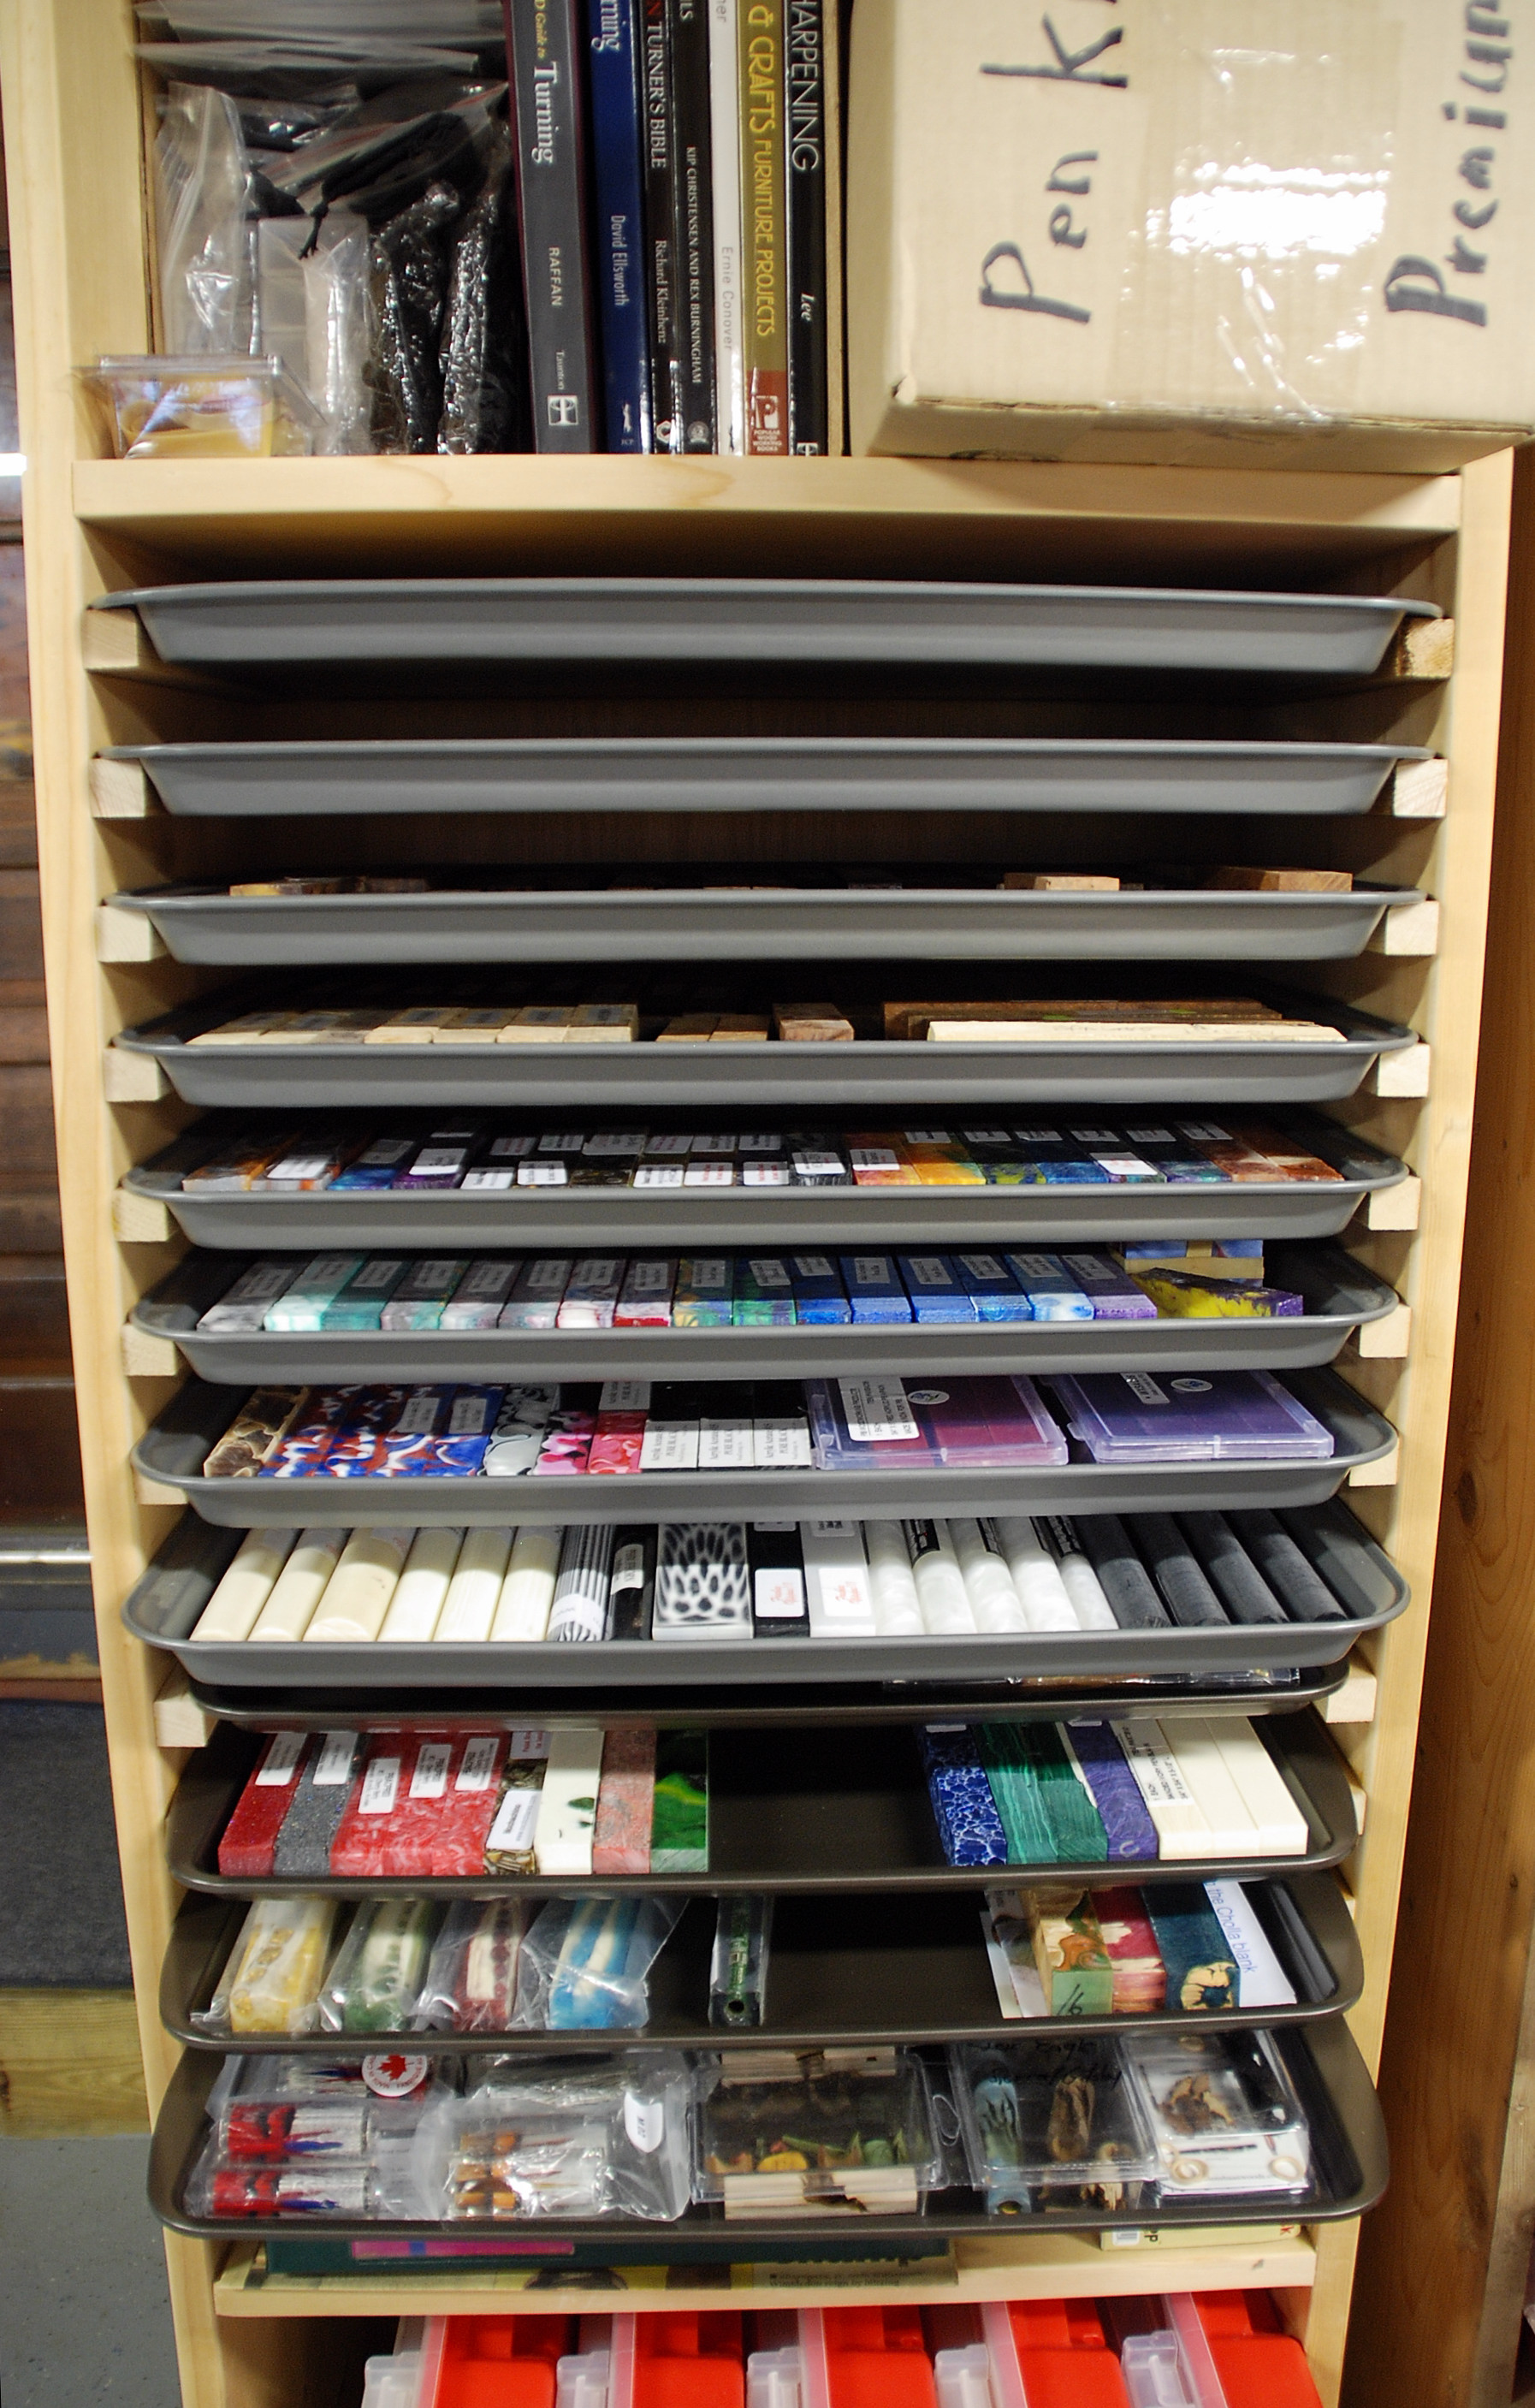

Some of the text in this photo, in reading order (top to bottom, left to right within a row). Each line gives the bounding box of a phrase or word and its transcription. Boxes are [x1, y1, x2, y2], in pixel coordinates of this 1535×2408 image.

[535, 13, 548, 46] Guide
[536, 48, 546, 59] to
[647, 21, 666, 116] TURNER'S
[531, 62, 559, 165] Turning
[651, 118, 667, 169] BIBLE
[748, 5, 775, 337] & CRAFTS FURNITURE PROJECTS
[979, 0, 1129, 324] Pen K
[548, 247, 562, 306] RAFFAN
[610, 215, 630, 306] David Ellsworth
[655, 240, 672, 343] Richard Kleinhenz
[686, 146, 703, 383] KIP CHRISTENSEN AND REX BURNINGHAM
[721, 246, 734, 350] Ernie Conover
[800, 291, 815, 322] Lee
[555, 350, 565, 390] Taunton
[1209, 1888, 1255, 1973] the Cholla blank
